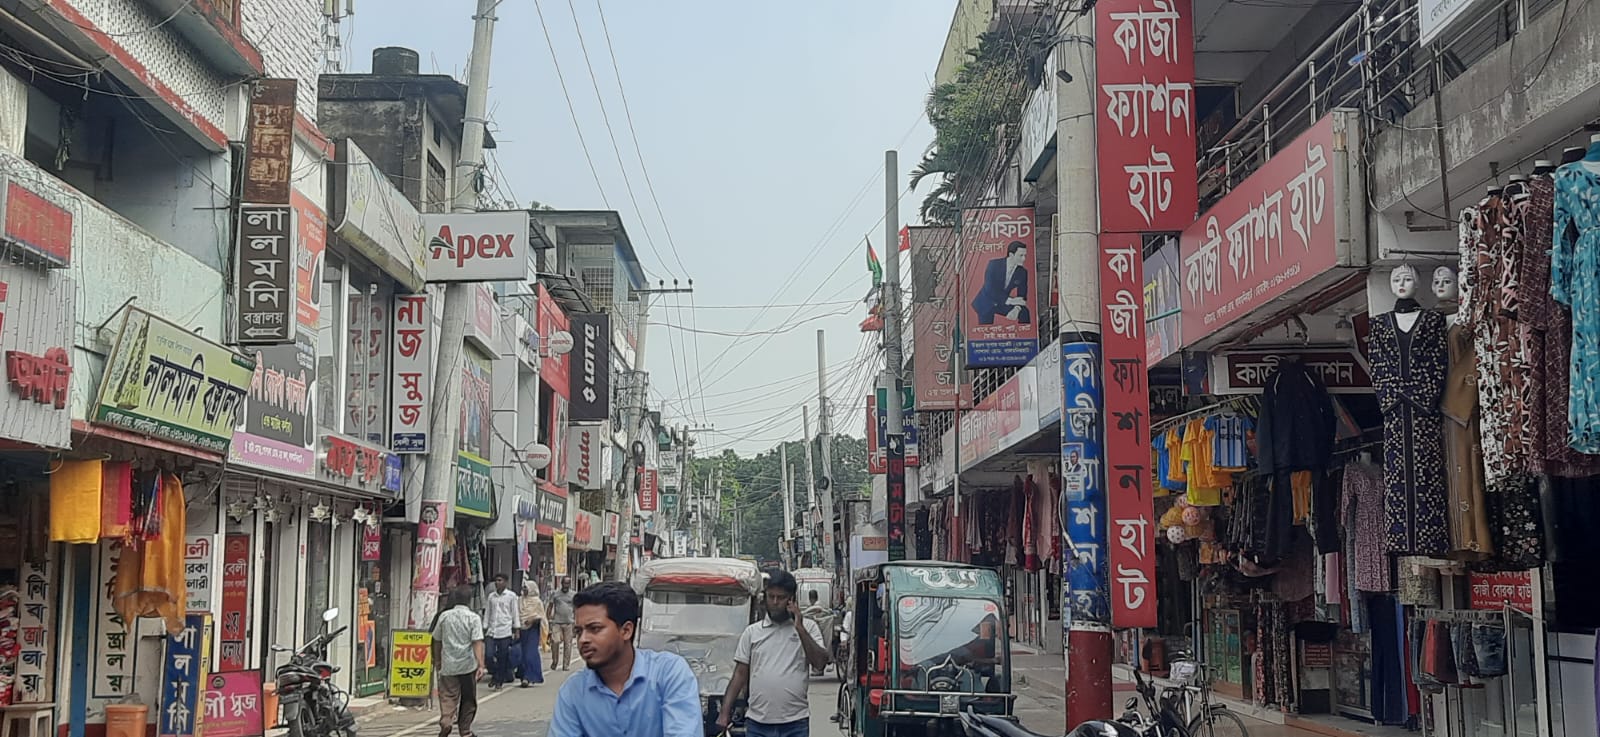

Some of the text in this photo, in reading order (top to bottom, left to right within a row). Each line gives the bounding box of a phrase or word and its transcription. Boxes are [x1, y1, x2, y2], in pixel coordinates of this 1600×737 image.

[1109, 0, 1180, 67] কাজী
[1101, 75, 1192, 138] ফ্যাশন
[1123, 144, 1175, 228] হাট
[1184, 215, 1222, 309] কাজী
[1225, 189, 1283, 284] ফ্যাশন
[1287, 140, 1328, 253] হাট
[432, 225, 515, 267] Apex
[243, 311, 285, 327] বস্ত্রালয়
[584, 324, 595, 385] LOTTO
[143, 353, 205, 424] লালমনি
[577, 431, 590, 485] Bata
[545, 499, 563, 523] LOTTO
[185, 538, 209, 558] লী
[224, 559, 246, 577] বেলী
[1472, 579, 1532, 600] কাজী বোরকা হাউ
[394, 643, 432, 664] নাজ
[394, 667, 430, 679] সুজ
[393, 683, 412, 693] পাওয়া
[204, 690, 258, 719] লী সুজ
